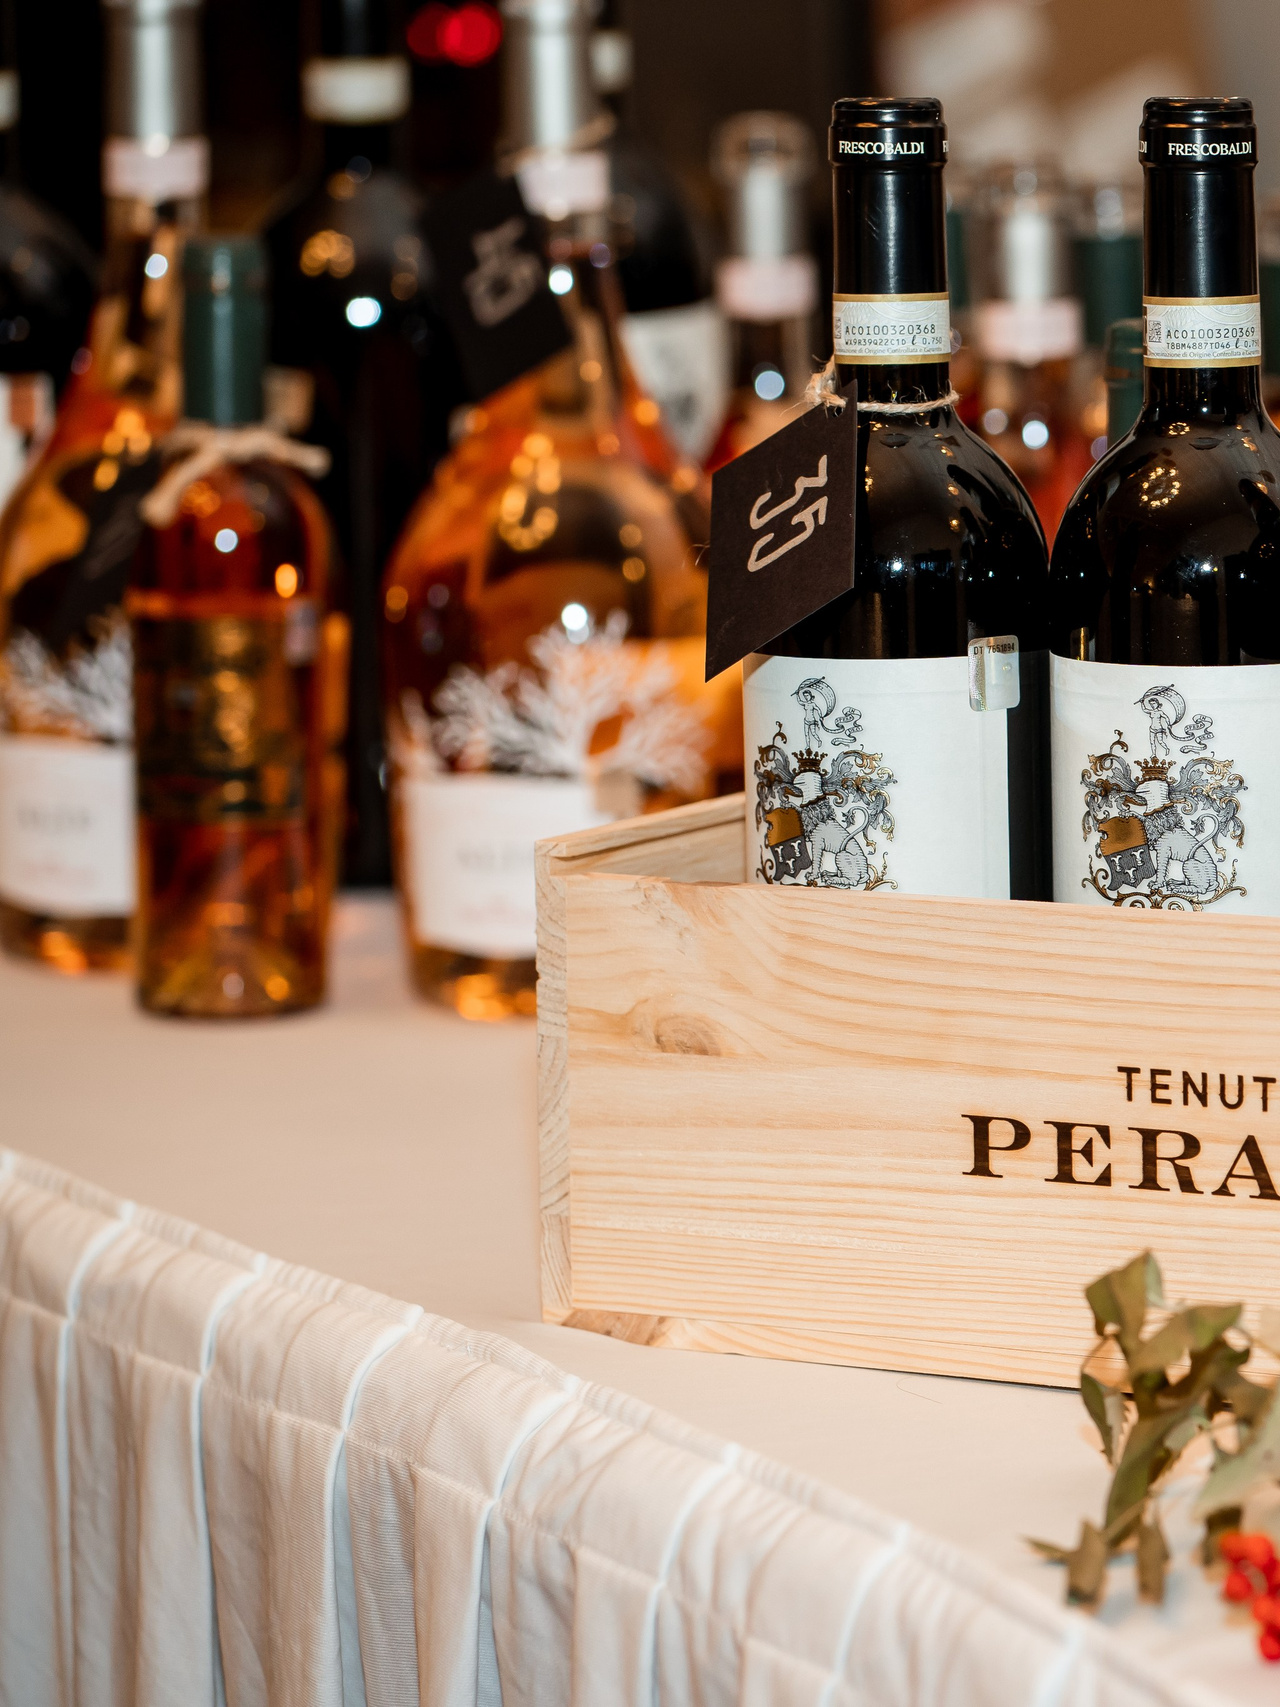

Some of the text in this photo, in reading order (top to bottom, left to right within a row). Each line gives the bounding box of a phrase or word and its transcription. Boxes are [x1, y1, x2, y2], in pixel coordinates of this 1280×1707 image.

[839, 141, 925, 154] FRESCOBALDI
[1168, 142, 1252, 155] FRESCOBALDI
[973, 646, 983, 655] DT
